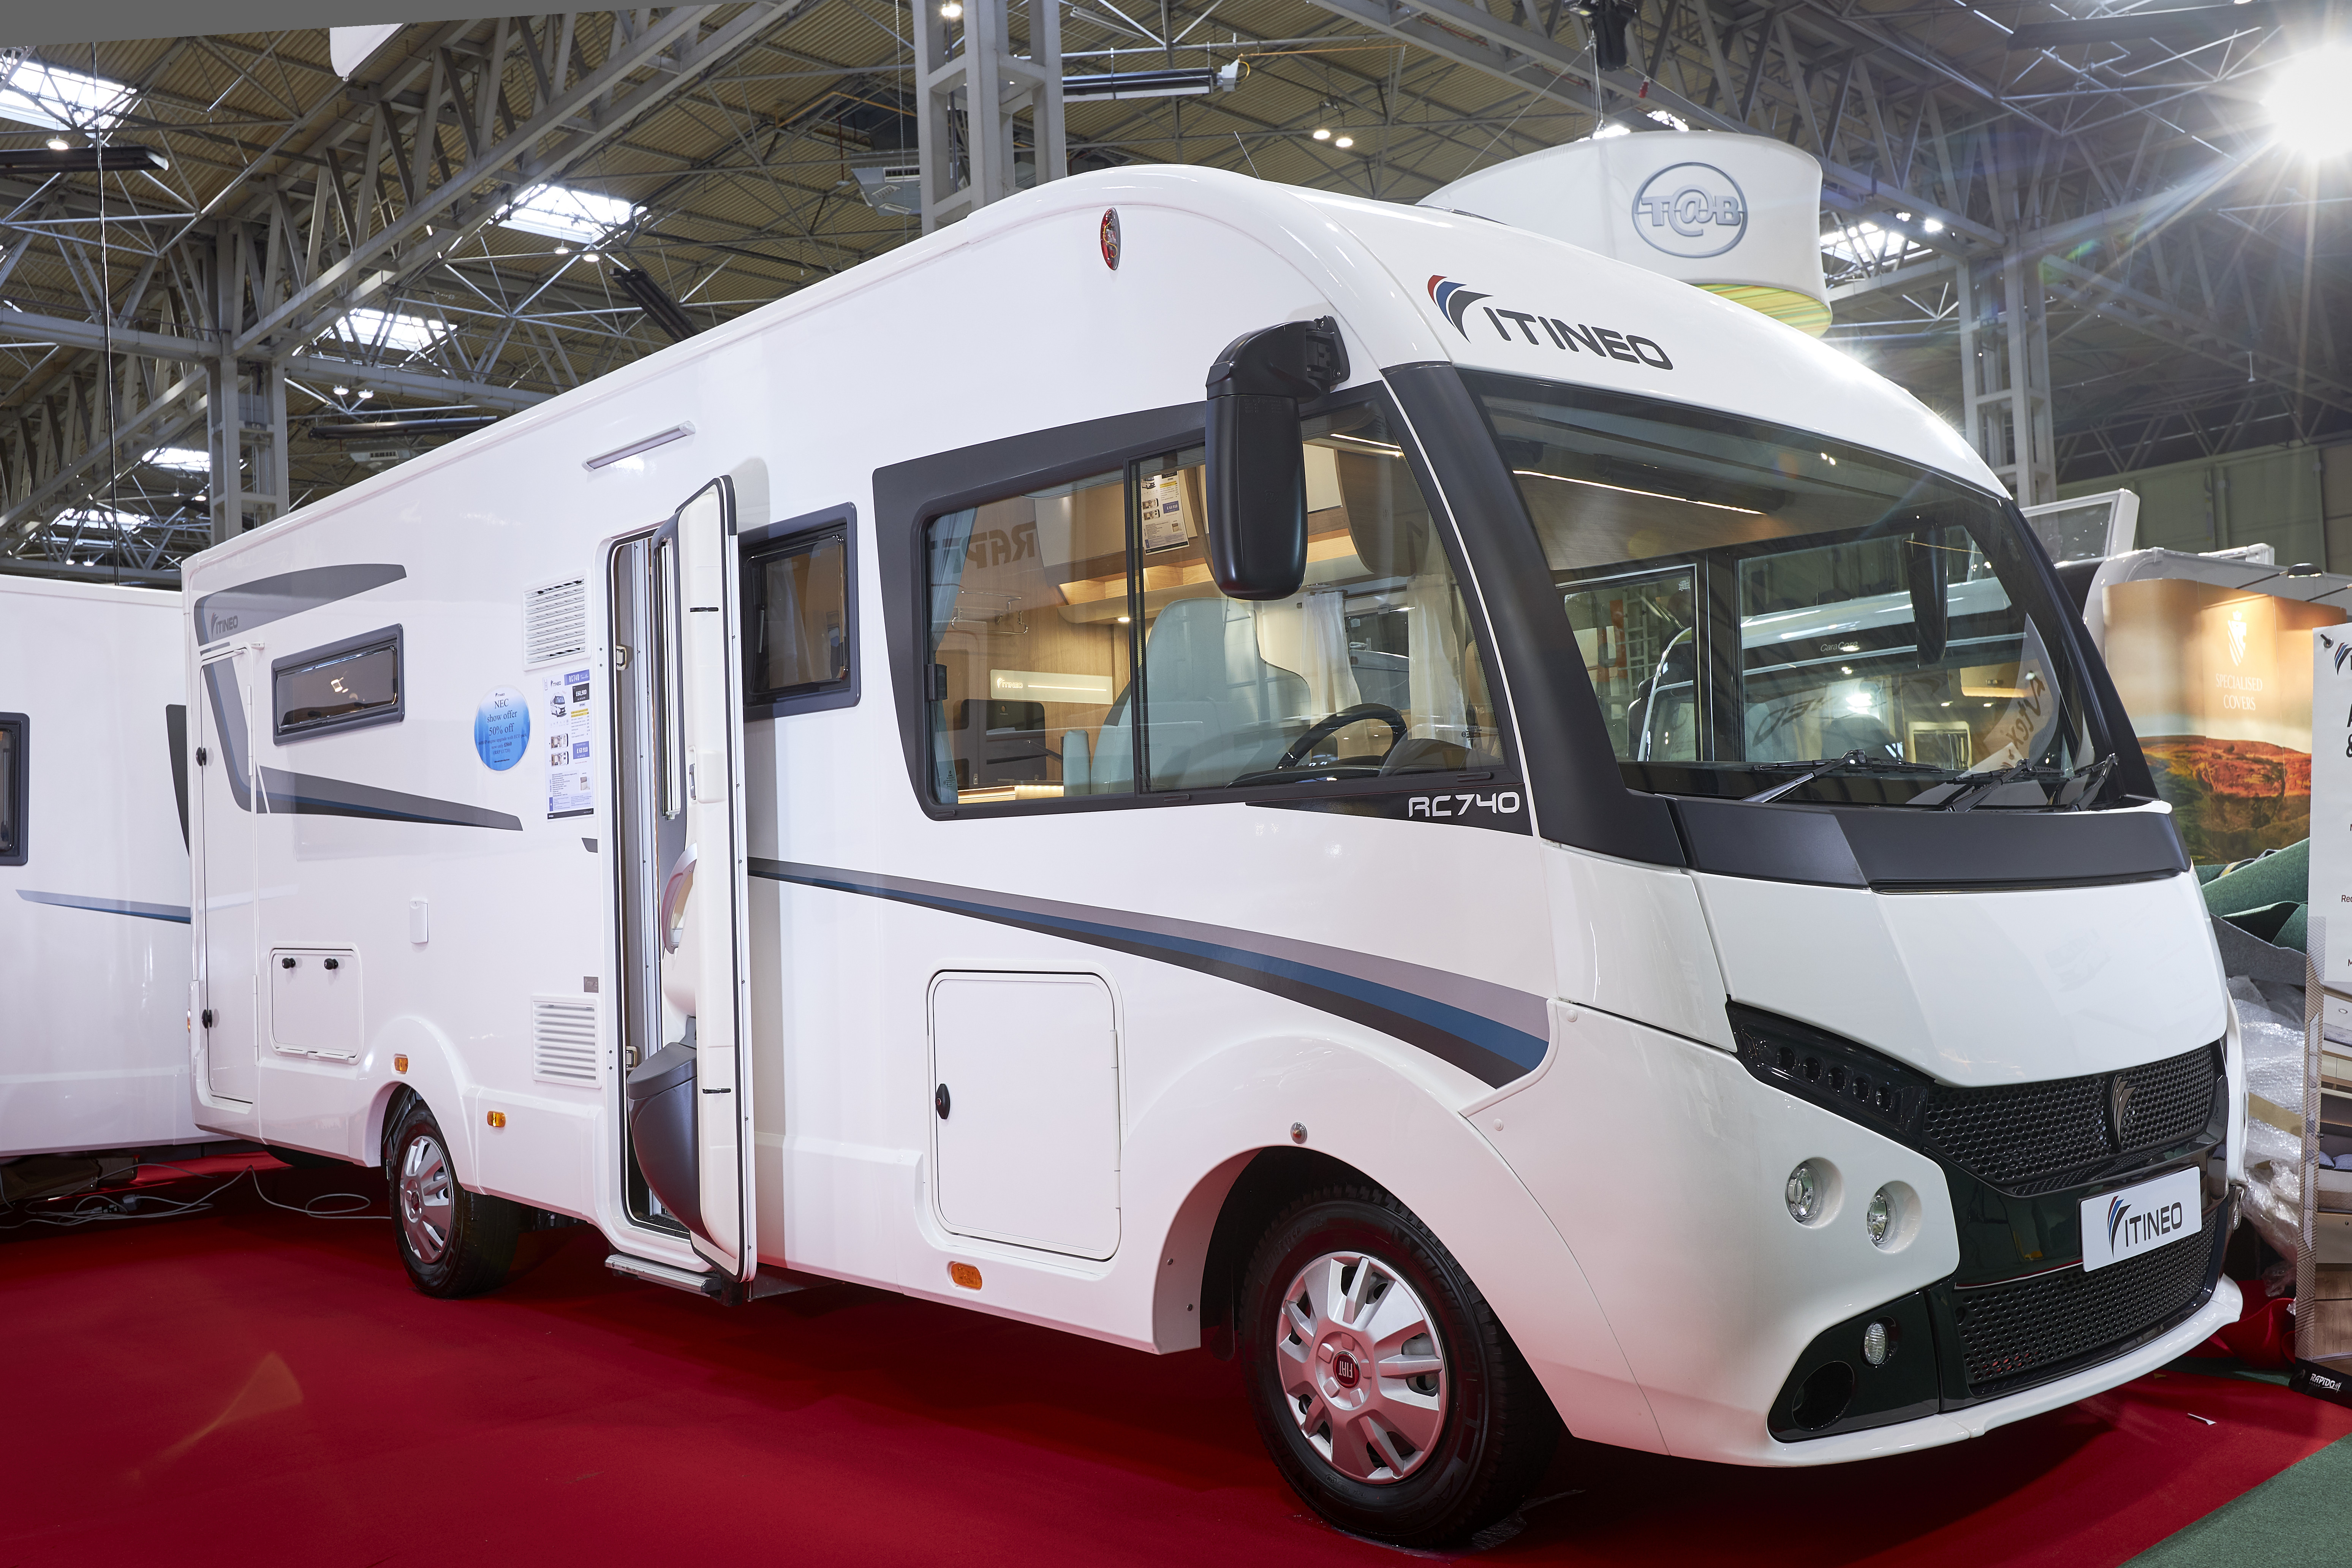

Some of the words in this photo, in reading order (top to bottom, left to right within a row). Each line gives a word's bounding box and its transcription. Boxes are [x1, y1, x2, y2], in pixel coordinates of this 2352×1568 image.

[1641, 185, 1741, 236] T@B
[1483, 307, 1673, 370] ITINEO
[216, 615, 238, 635] ITINEO
[1821, 641, 1858, 652] CaraCore
[2216, 673, 2263, 691] SPECIALISED
[495, 699, 509, 709] NEC
[2223, 694, 2256, 711] COVERS
[487, 714, 502, 723] show
[503, 710, 517, 719] offer
[489, 725, 503, 736] 50%
[505, 722, 514, 733] off
[1408, 792, 1520, 817] RC740
[2125, 1201, 2183, 1247] ITINEO
[1338, 1361, 1353, 1378] FIAT
